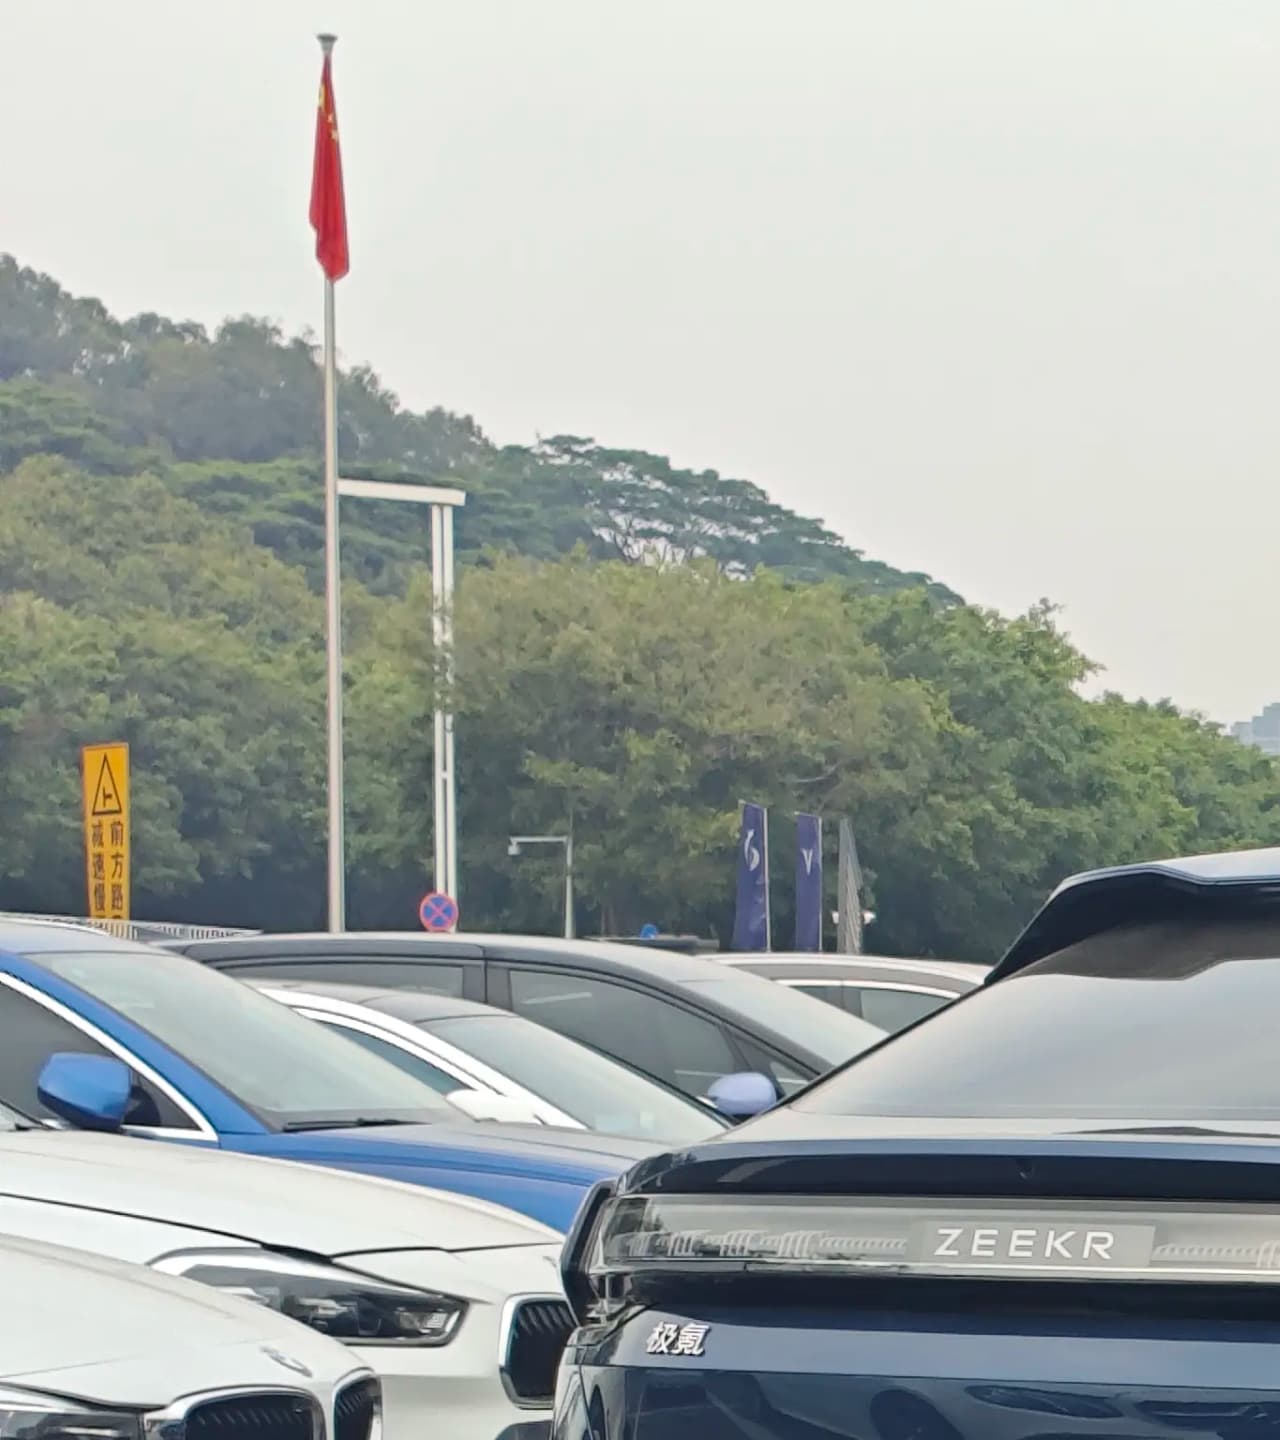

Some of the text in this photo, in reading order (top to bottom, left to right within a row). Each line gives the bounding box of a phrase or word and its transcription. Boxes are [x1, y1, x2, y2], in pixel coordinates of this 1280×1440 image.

[91, 820, 106, 919] 减速慢
[110, 820, 124, 919] 前方路
[934, 1228, 1114, 1260] ZEEKR
[647, 1321, 709, 1355] 极氪
